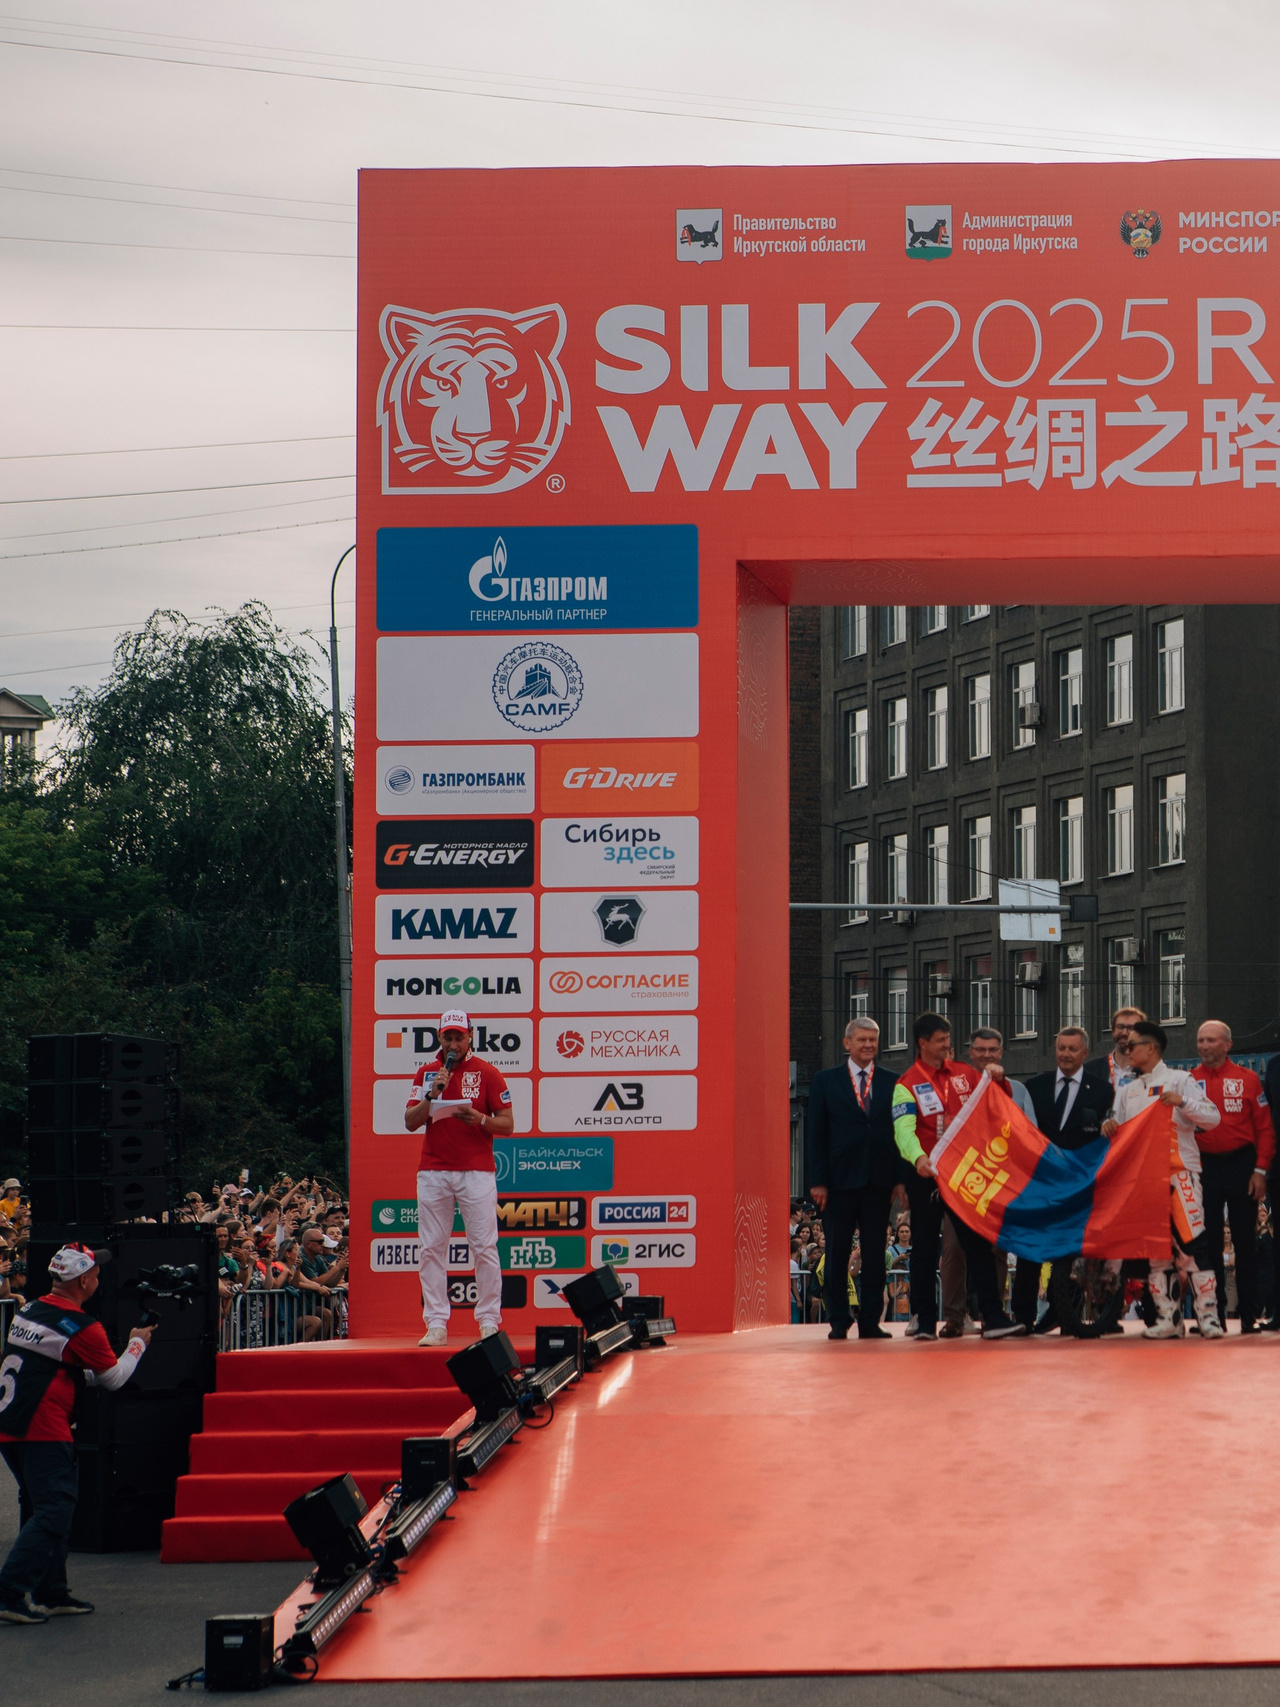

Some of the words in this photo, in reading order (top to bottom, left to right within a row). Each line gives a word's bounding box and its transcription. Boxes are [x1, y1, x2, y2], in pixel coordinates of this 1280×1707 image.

[733, 213, 838, 235] Правительство
[962, 211, 1073, 232] Администрация
[733, 235, 808, 258] Иркутской
[810, 235, 867, 252] области
[962, 236, 1010, 255] города
[1013, 233, 1078, 254] Иркутска
[1178, 236, 1268, 254] РОССИИ
[595, 302, 888, 395] SILK
[906, 297, 1176, 389] 2025
[596, 401, 888, 492] WAY
[510, 576, 608, 602] ГАЗПРОМ
[469, 607, 554, 622] ГЕНЕРАЛЬНЫЙ
[557, 608, 608, 621] ПАРТНЕР
[505, 702, 571, 717] CAMF
[422, 772, 526, 787] ГАЗПРОМБАНК
[564, 823, 661, 846] Сибирь
[443, 842, 494, 850] МОТОРНОЕ
[603, 846, 676, 865] здесь
[391, 907, 518, 940] KAMAZ
[386, 976, 522, 996] MONGOLIA
[586, 973, 690, 989] СОГЛАСИЕ
[630, 990, 690, 1000] страхование
[590, 1029, 670, 1043] РУССКАЯ
[590, 1044, 682, 1058] МЕХАНИКА
[1223, 1098, 1244, 1106] SILK
[1225, 1105, 1243, 1113] WAY
[574, 1116, 662, 1125] ЛЕНЗОЛОТО
[518, 1146, 605, 1158] БАЙКАЛЬСК
[518, 1160, 582, 1171] ЭКО.ЦЕХ
[1176, 1171, 1196, 1204] KFC
[604, 1205, 662, 1220] РОССИЯ
[669, 1205, 688, 1219] 24
[377, 1244, 420, 1266] ИЗВЕС
[449, 1244, 469, 1263] iz
[511, 1238, 557, 1268] НТВ
[634, 1242, 686, 1259] 2ГИС
[449, 1282, 479, 1303] 36
[10, 1325, 44, 1346] PODIUM
